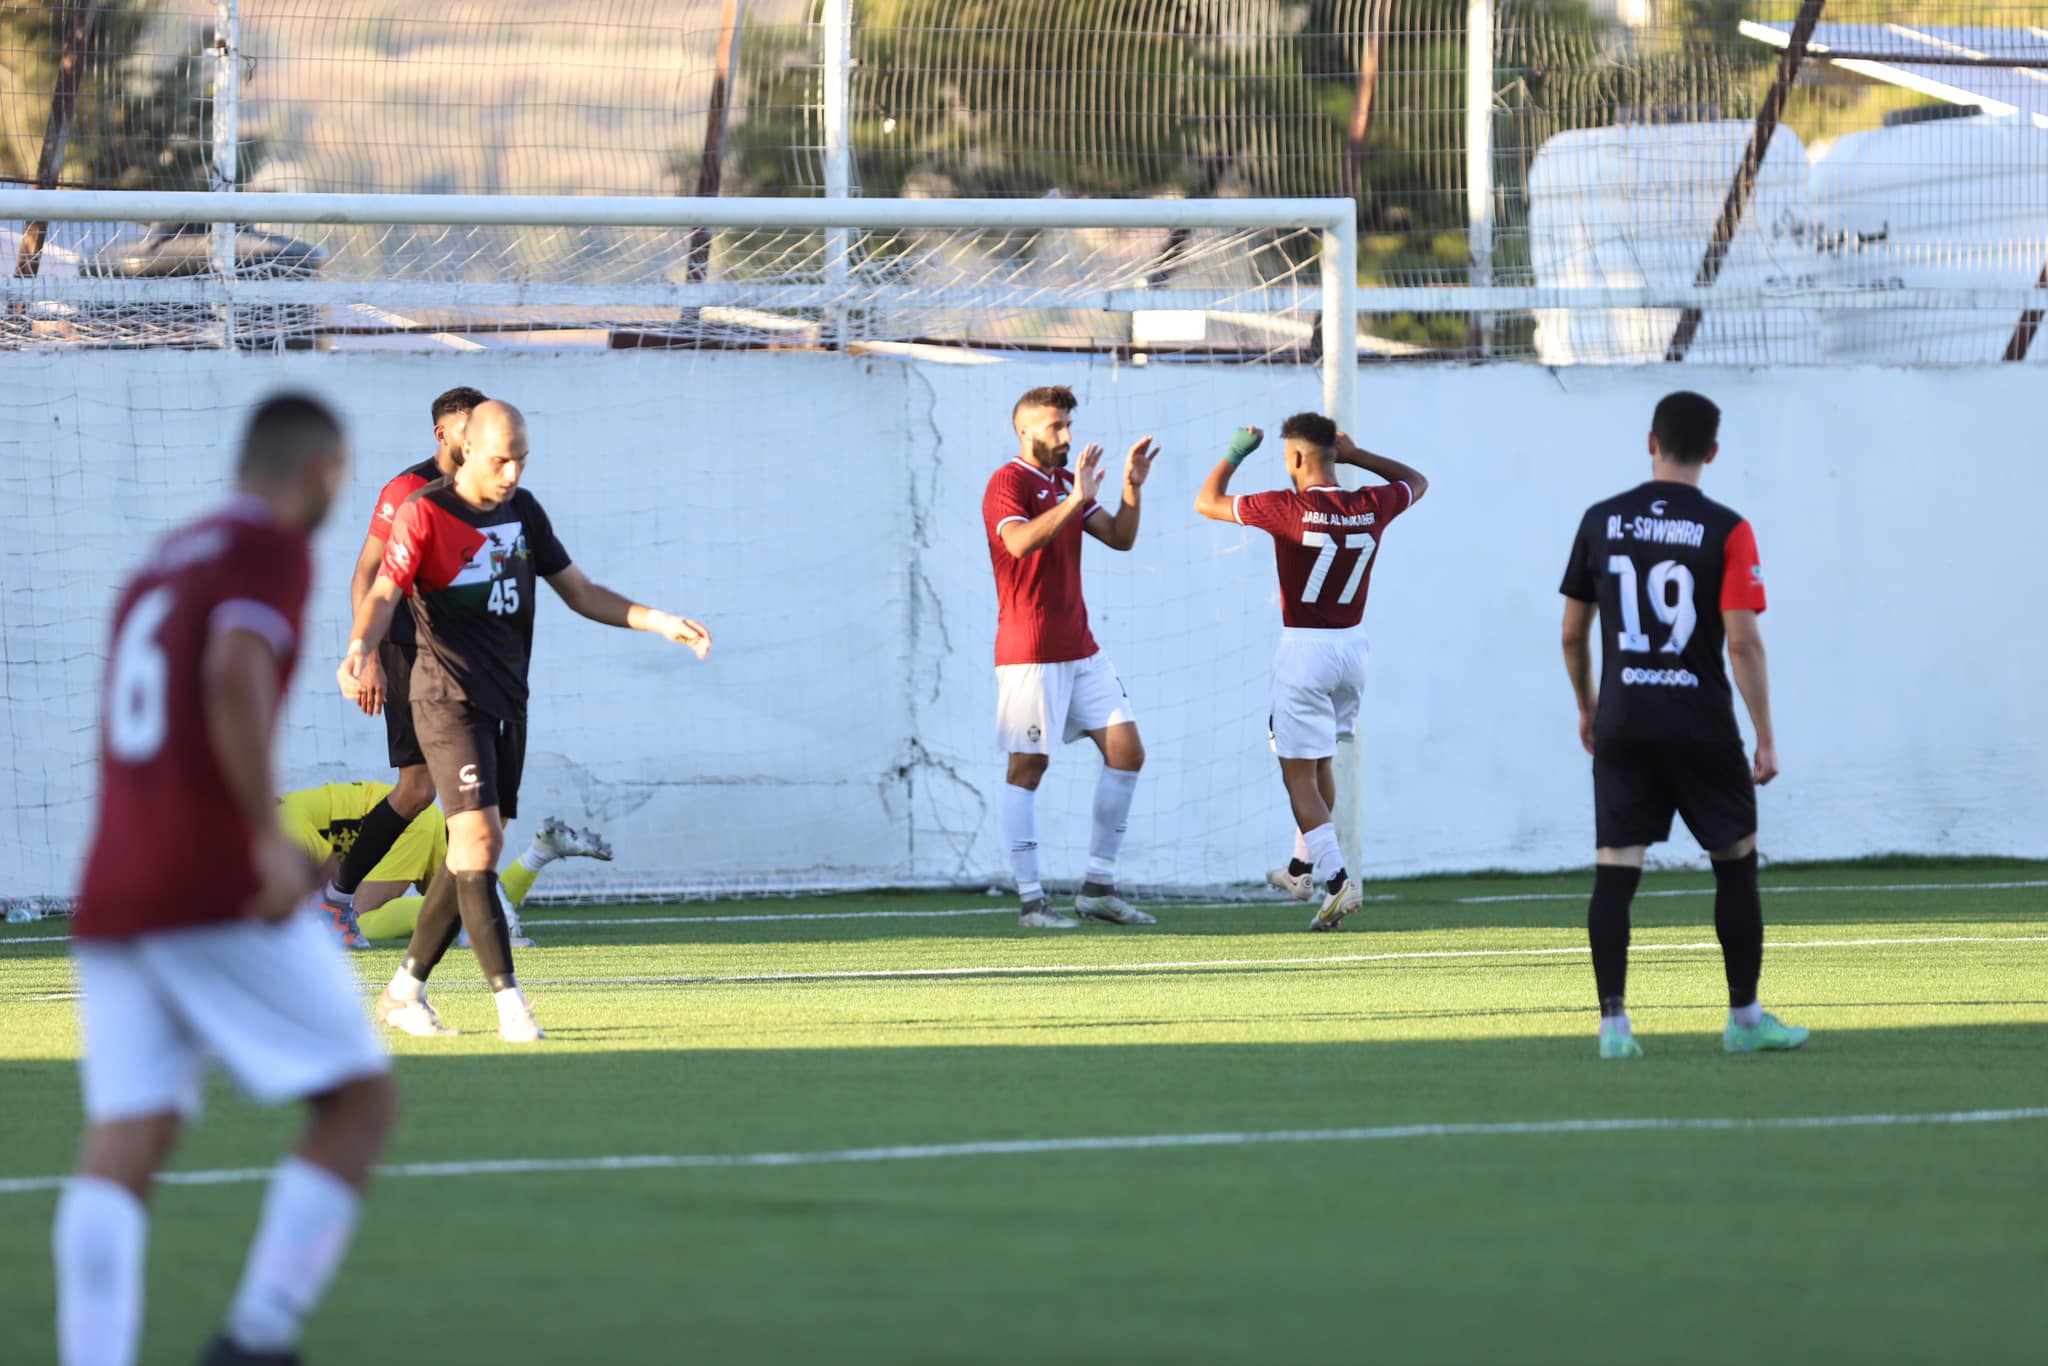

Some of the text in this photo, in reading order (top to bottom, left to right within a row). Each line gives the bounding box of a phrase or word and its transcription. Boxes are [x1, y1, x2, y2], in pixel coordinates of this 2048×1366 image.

[1302, 511, 1329, 524] JABAL
[1330, 513, 1341, 526] AL
[1607, 513, 1704, 547] AL-SAWAHRA
[1301, 530, 1376, 604] 77
[487, 577, 519, 615] 45
[1608, 554, 1697, 655] 19
[111, 583, 171, 759] 6
